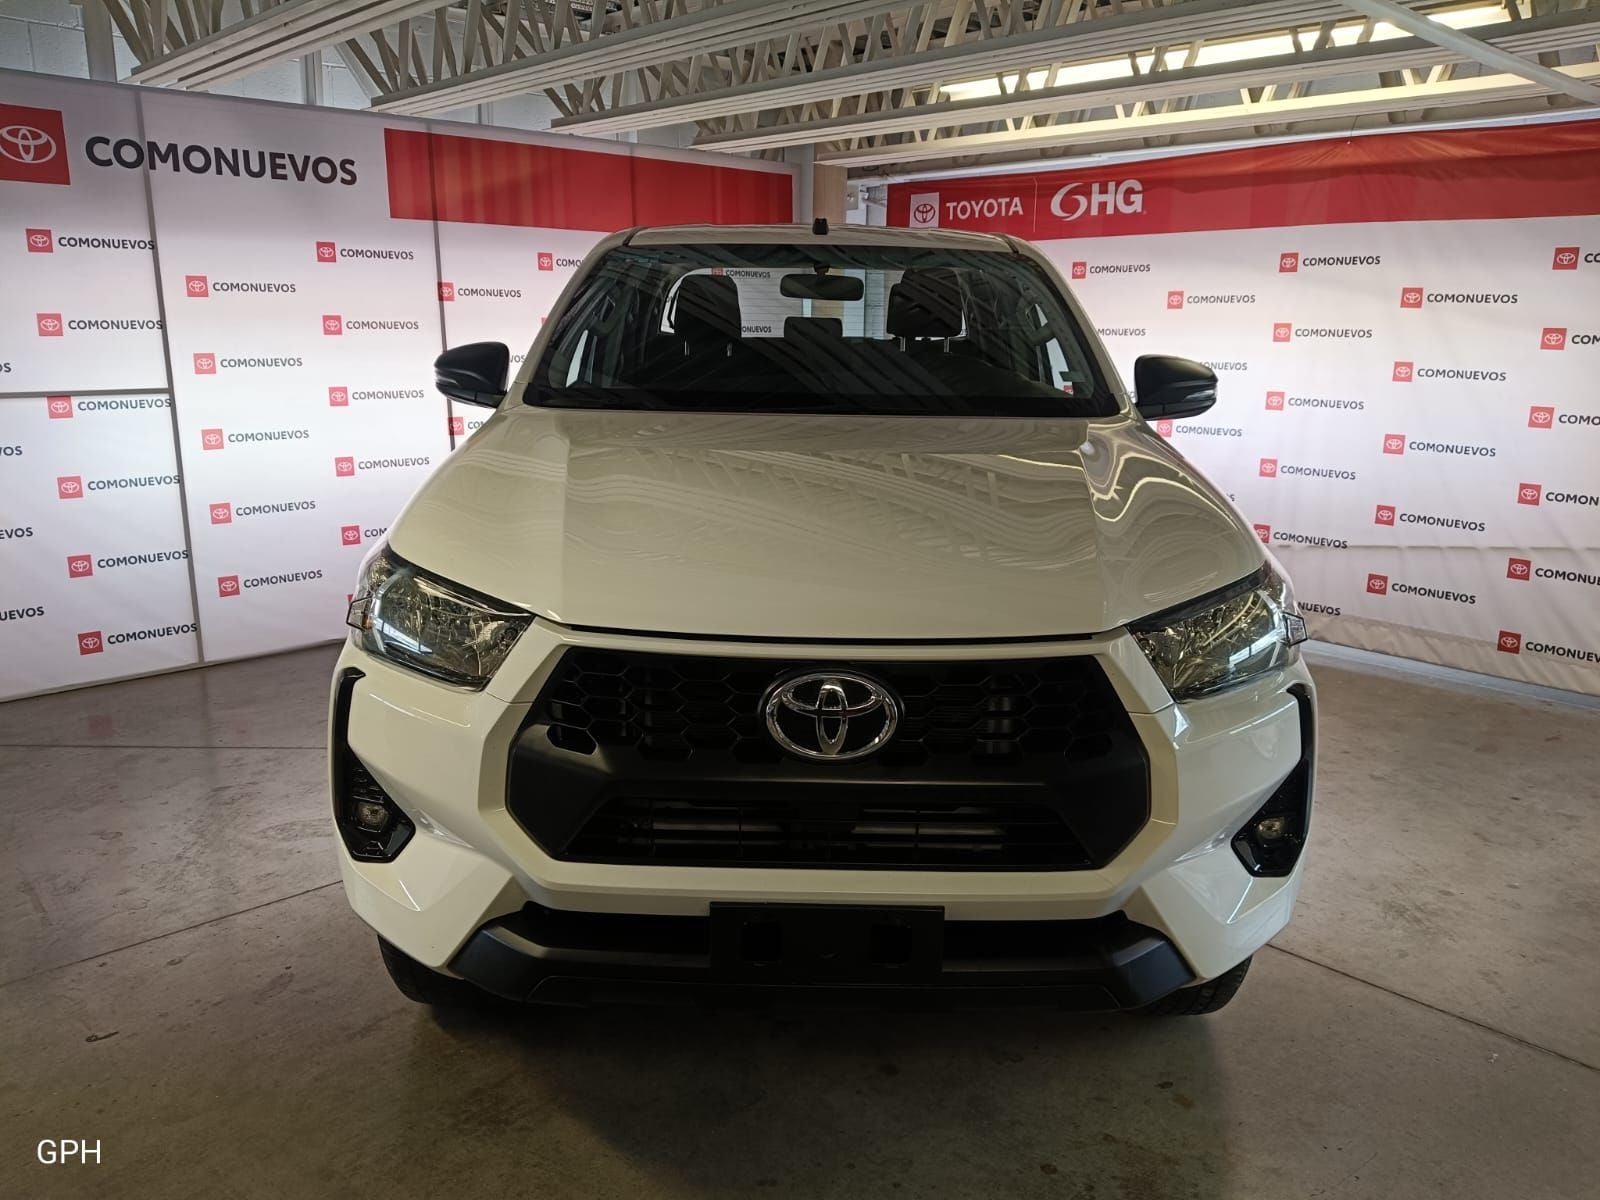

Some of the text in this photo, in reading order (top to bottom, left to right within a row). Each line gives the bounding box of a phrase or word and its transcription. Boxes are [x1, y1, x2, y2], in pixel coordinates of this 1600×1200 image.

[86, 136, 357, 186] COMONUEVOS
[1091, 179, 1142, 215] HG
[946, 197, 1023, 220] TOYOTA
[59, 236, 155, 250] COMONUEVOS
[340, 248, 414, 260] COMONUEVOS
[1303, 256, 1380, 267] COMONUEVOS
[726, 270, 770, 278] COMONUEVOS
[1089, 264, 1150, 274] COMONUEVOS
[213, 281, 296, 294] COMONUEVOS
[458, 287, 521, 298] COMONUEVOS
[1187, 294, 1255, 304] COMONUEVOS
[1427, 293, 1517, 304] COMONUEVOS
[68, 319, 163, 331] COMONUEVOS
[346, 320, 419, 331] COMONUEVOS
[1295, 328, 1372, 338] COMONUEVOS
[220, 357, 302, 369] COMONUEVOS
[1417, 367, 1506, 381] COMONUEVOS
[352, 390, 424, 401] COMONUEVOS
[78, 398, 171, 412] COMONUEVOS
[1288, 397, 1364, 410] COMONUEVOS
[228, 430, 309, 444] COMONUEVOS
[1175, 425, 1242, 437] COMONUEVOS
[1409, 441, 1496, 457] COMONUEVOS
[358, 457, 430, 470] COMONUEVOS
[1280, 464, 1356, 480] COMONUEVOS
[88, 475, 180, 491] COMONUEVOS
[1546, 491, 1599, 506] COMON
[235, 501, 315, 517] COMONUEVOS
[1399, 512, 1485, 532] COMONUEVOS
[1273, 531, 1348, 549] COMONUEVOS
[97, 550, 189, 569] COMONUEVOS
[243, 570, 322, 588] COMONUEVOS
[1392, 583, 1475, 605] COMONUEVOS
[0, 606, 44, 621] UEVOS
[1298, 602, 1341, 615] NUEVOS
[107, 623, 197, 645] COMONUEVOS
